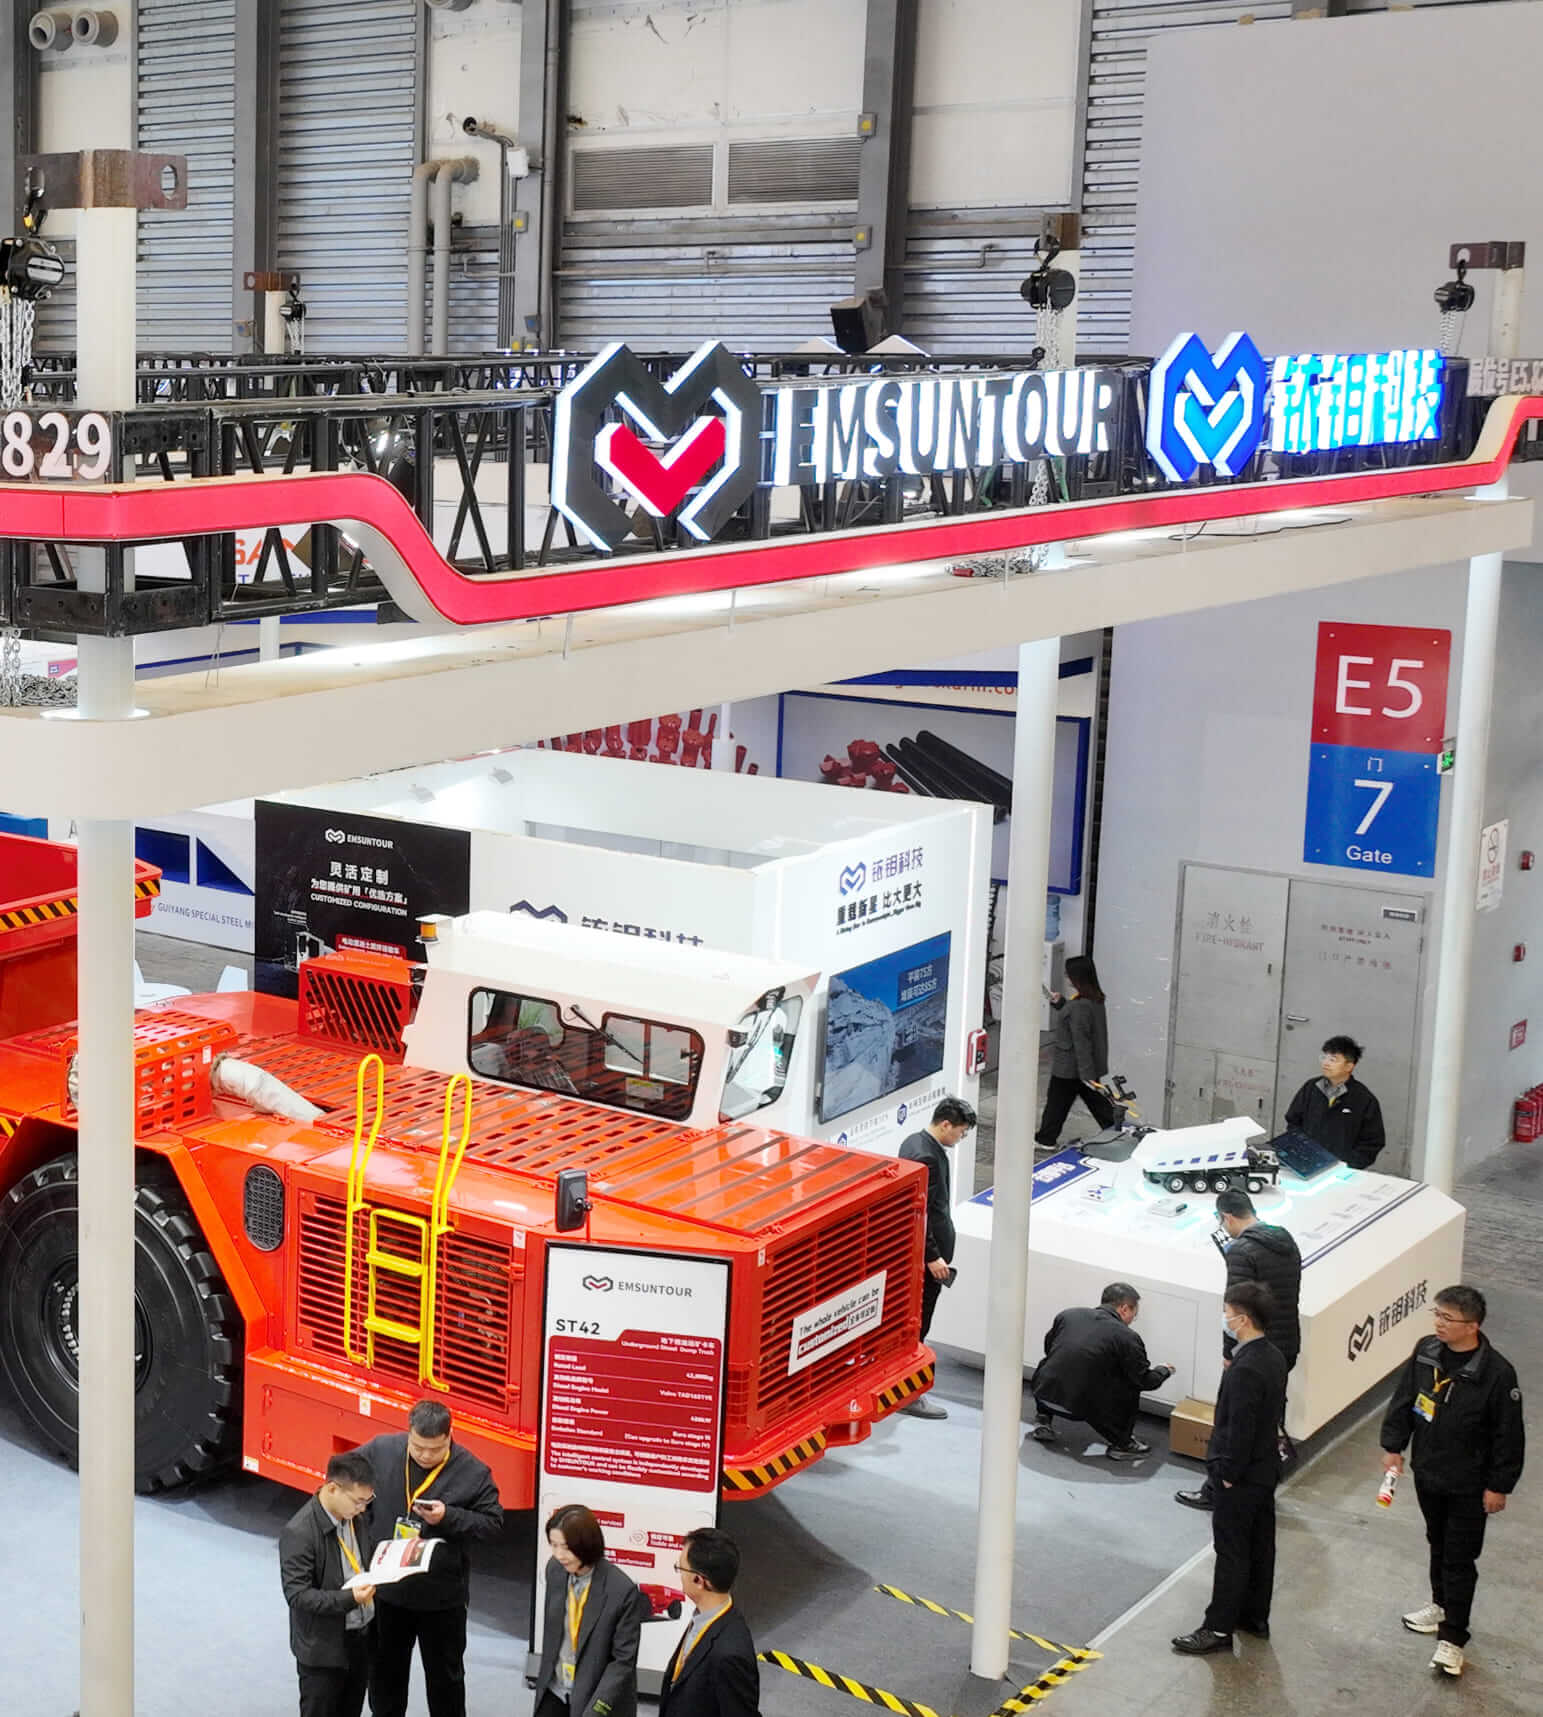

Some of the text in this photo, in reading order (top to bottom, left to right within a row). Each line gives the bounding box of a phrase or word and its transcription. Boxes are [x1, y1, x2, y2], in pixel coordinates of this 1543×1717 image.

[774, 368, 1112, 486] EMSUNTOUR
[1335, 655, 1425, 719] E5
[1354, 779, 1394, 836] 7
[347, 834, 394, 849] EMSUNTOUR
[1346, 845, 1394, 865] Gate
[158, 903, 190, 917] GUIYANG
[191, 910, 220, 923] SPECIAL
[221, 915, 243, 928] STEEL
[310, 893, 407, 917] CUSTOMIZED CONFIGURATION
[618, 1281, 693, 1298] EMSUNTOUR
[555, 1319, 601, 1336] ST42
